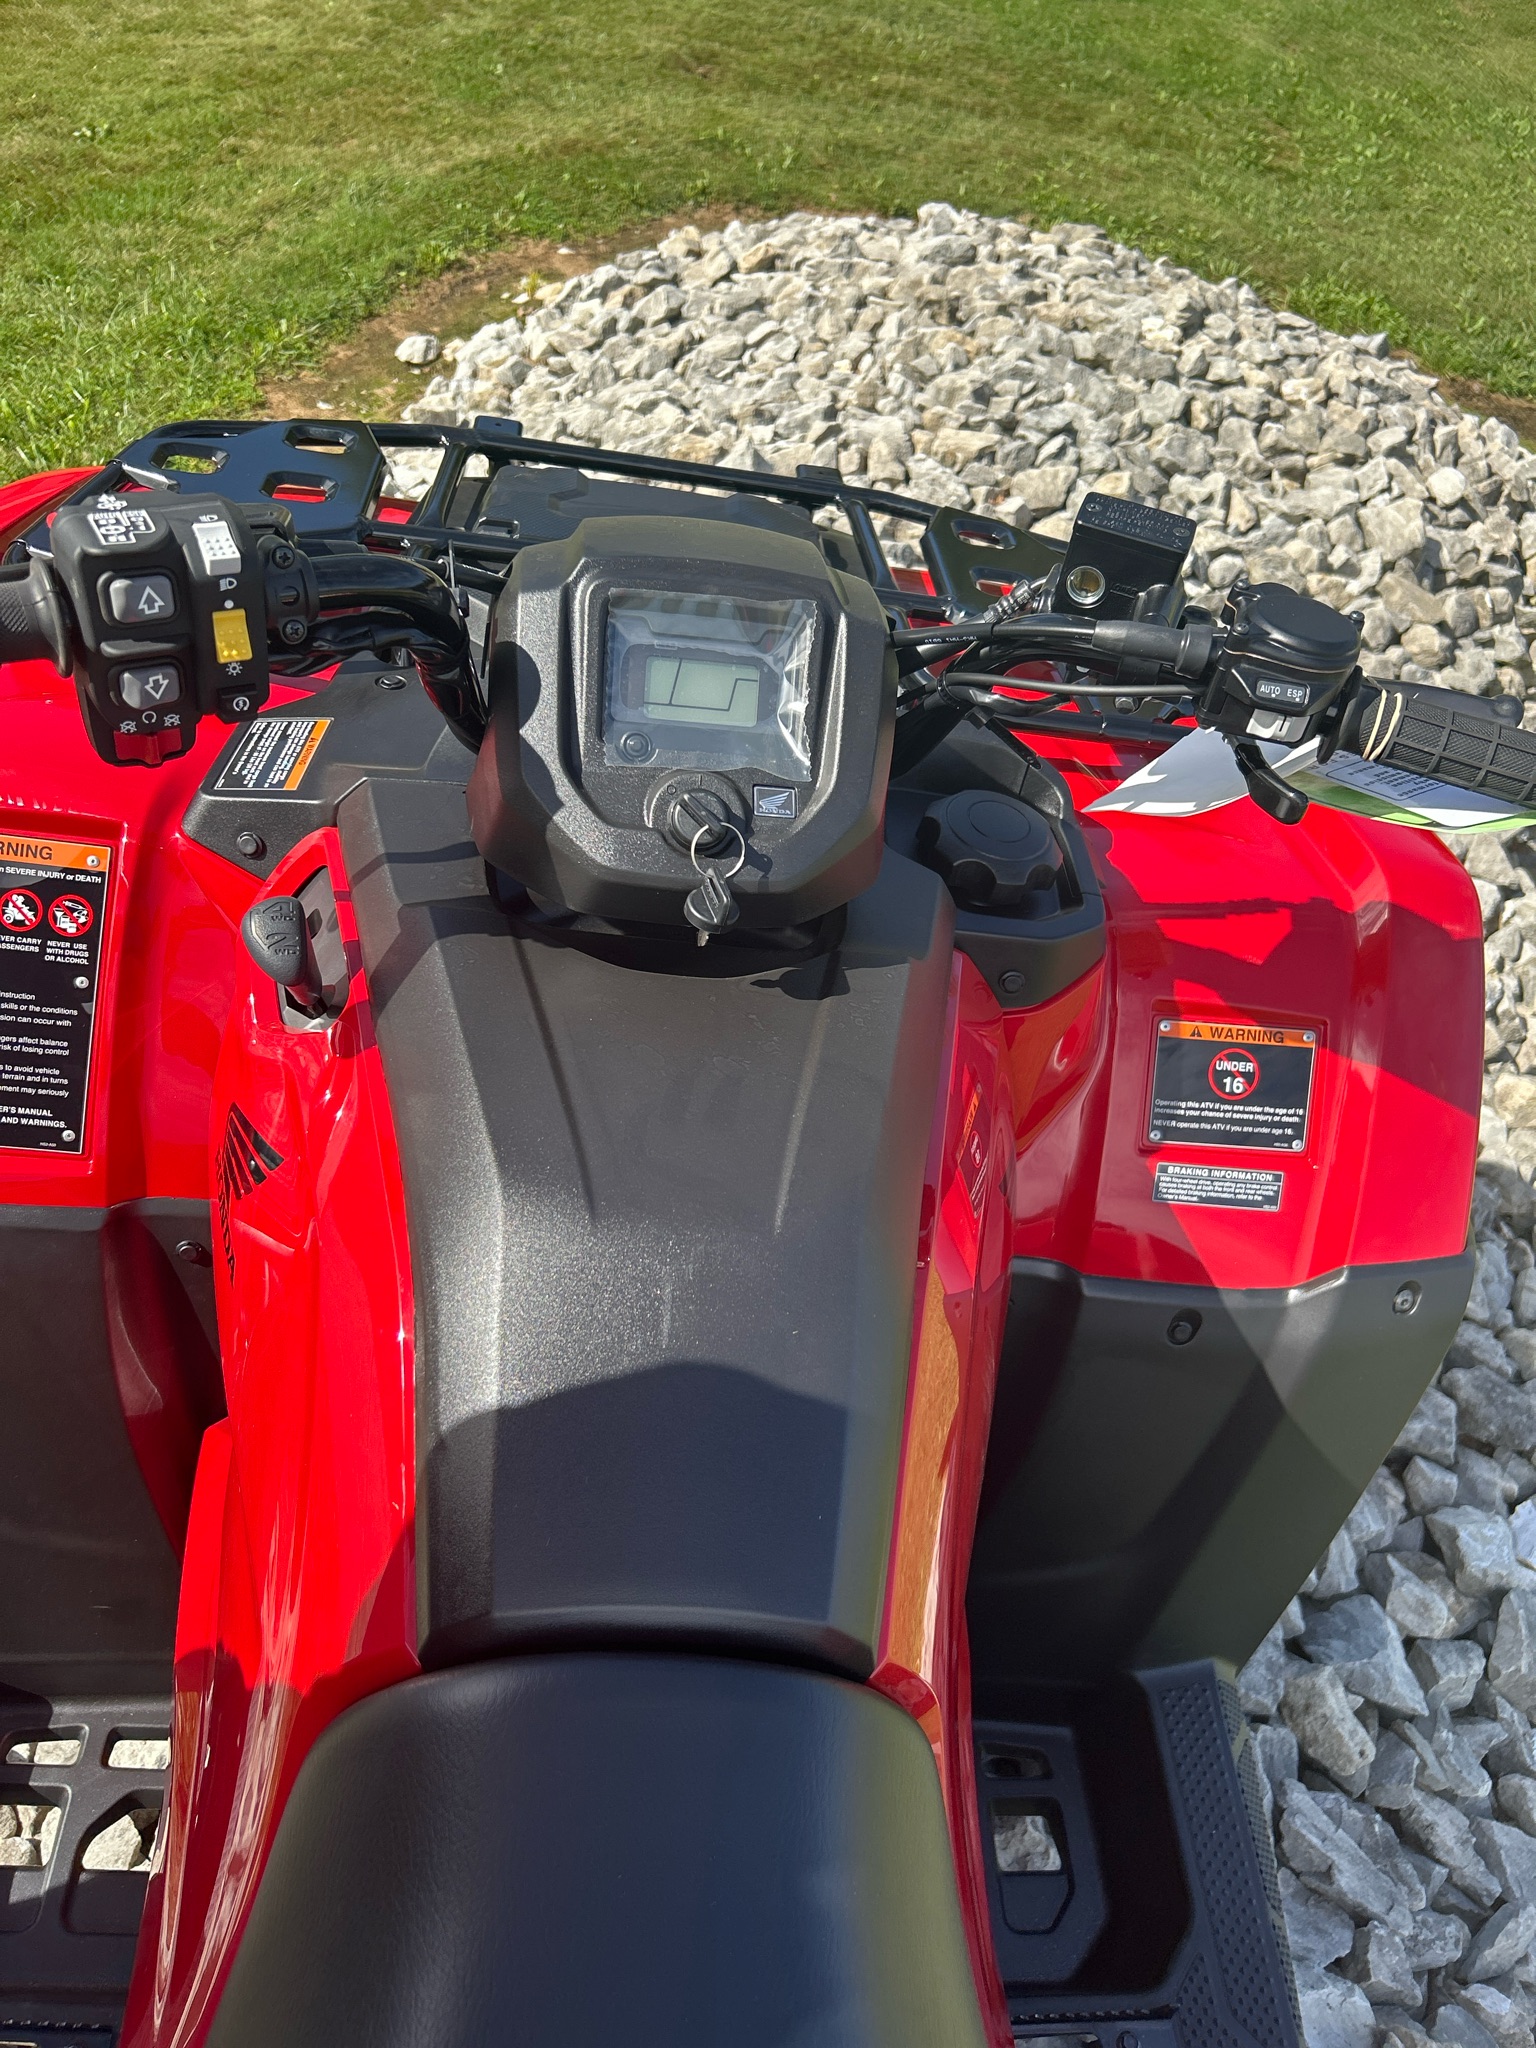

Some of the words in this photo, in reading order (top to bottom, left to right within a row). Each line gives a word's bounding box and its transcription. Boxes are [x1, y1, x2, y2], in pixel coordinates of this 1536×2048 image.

[1260, 684, 1280, 694] AUTO
[1286, 688, 1303, 698] ESP
[759, 807, 792, 815] HONDA
[6, 867, 36, 876] SEVERE
[38, 871, 65, 879] INJURY
[76, 875, 102, 884] DEATH
[0, 934, 15, 942] VER
[17, 937, 42, 945] CARRY
[47, 940, 70, 948] NEVER
[56, 956, 89, 965] ALCOHOL
[1, 1002, 18, 1010] skills
[29, 1004, 40, 1012] the
[42, 1006, 78, 1016] conditions
[1210, 1026, 1284, 1044] WARNING
[40, 1038, 68, 1047] balance
[22, 1046, 43, 1055] losing
[45, 1048, 69, 1056] control
[35, 1067, 60, 1075] vehicle
[1215, 1060, 1254, 1073] UNDER
[2, 1073, 25, 1081] terrain
[51, 1077, 68, 1085] turns
[1222, 1076, 1244, 1094] 16
[21, 1087, 36, 1095] may
[38, 1088, 69, 1098] seriously
[18, 1107, 53, 1117] MANUAL
[1154, 1098, 1185, 1107] Operating
[1274, 1107, 1286, 1115] age
[1, 1116, 19, 1124] AND
[21, 1117, 67, 1128] WARNINGS.
[1254, 1113, 1273, 1122] injury
[1176, 1121, 1199, 1129] operate
[1167, 1165, 1208, 1176] BRAKING
[1210, 1169, 1272, 1182] INFORMATION
